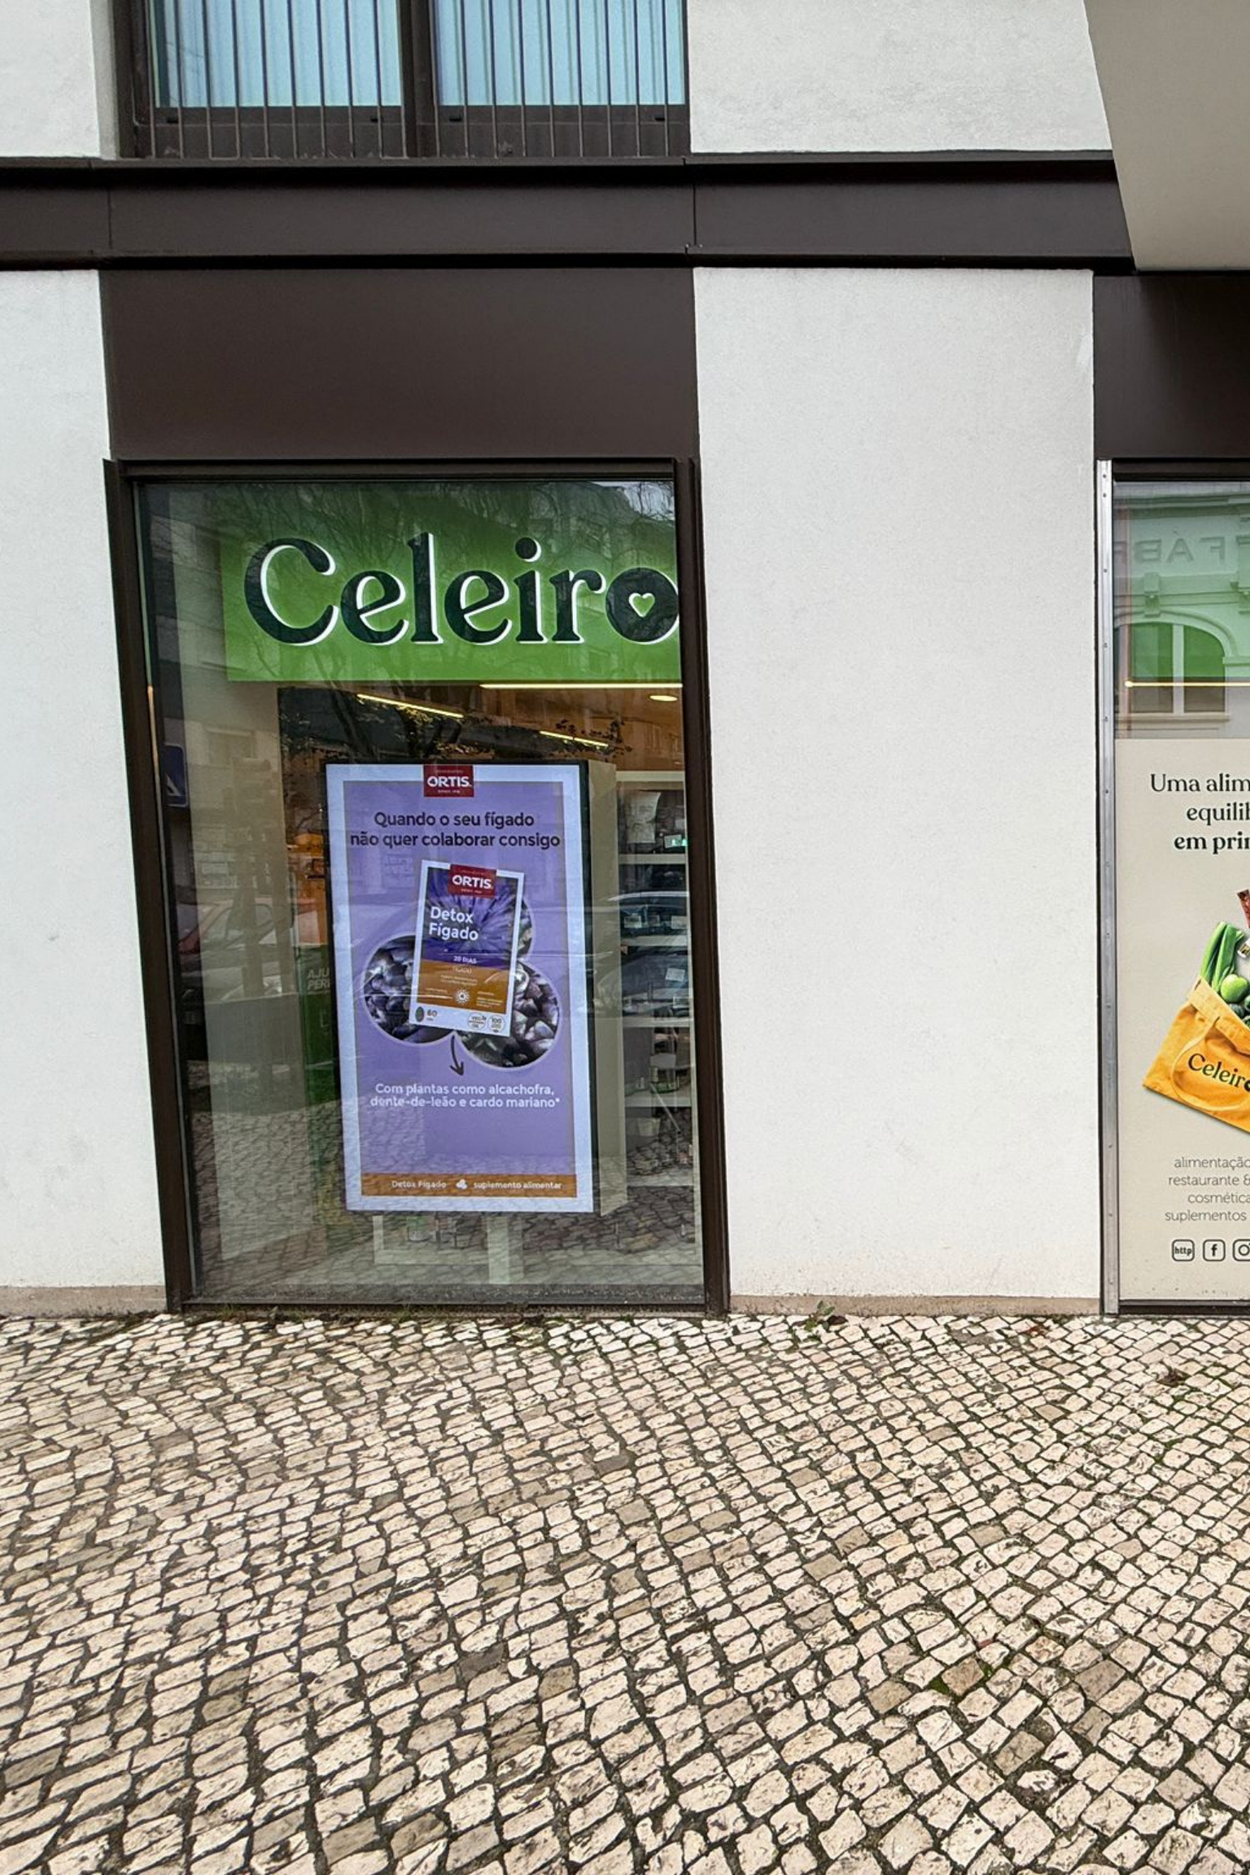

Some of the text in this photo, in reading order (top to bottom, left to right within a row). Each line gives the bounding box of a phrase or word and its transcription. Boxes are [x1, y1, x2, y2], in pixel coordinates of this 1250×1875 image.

[243, 532, 679, 646] Celeiro
[426, 775, 471, 788] ORTIS
[1150, 773, 1200, 792] Uma
[374, 811, 534, 830] Quando o seu fígado
[350, 831, 560, 850] não quer colaborar consigo
[1174, 836, 1206, 850] em
[452, 874, 492, 890] ORTIS
[430, 906, 473, 923] Detox
[428, 921, 479, 941] Fígado
[375, 1083, 555, 1097] Com plantas como alcachofra,
[370, 1096, 456, 1108] dente-de-leão
[459, 1098, 466, 1108] e
[469, 1096, 503, 1108] cardo
[391, 1180, 416, 1189] Detox
[473, 1180, 521, 1190] suplemento
[523, 1180, 562, 1189] alimentar
[1168, 1176, 1240, 1186] restaurante
[1165, 1210, 1247, 1223] suplementos
[1174, 1245, 1192, 1257] http
